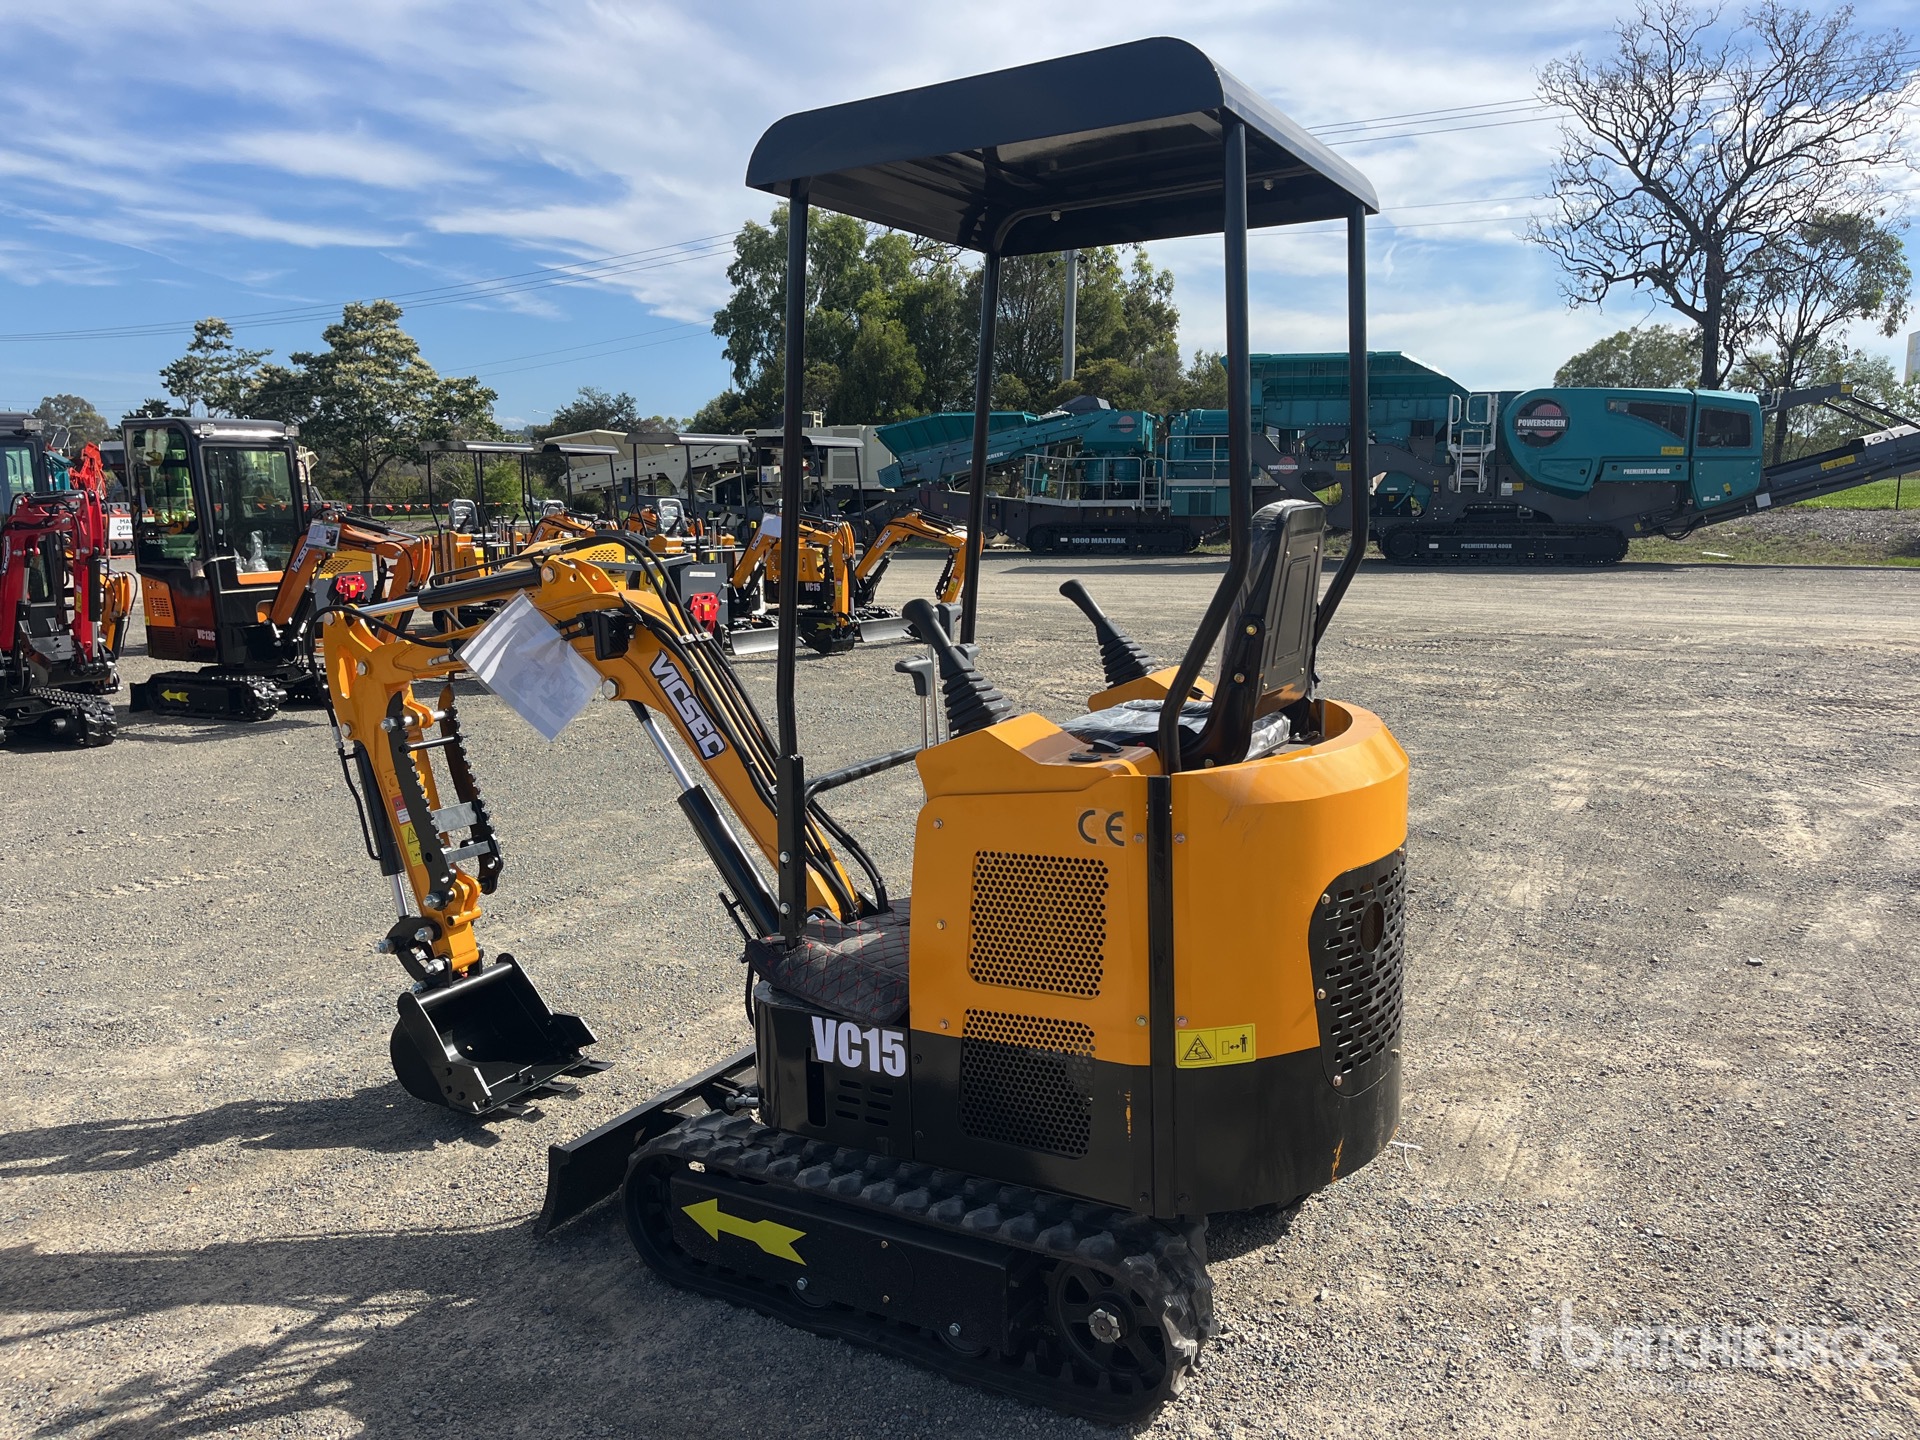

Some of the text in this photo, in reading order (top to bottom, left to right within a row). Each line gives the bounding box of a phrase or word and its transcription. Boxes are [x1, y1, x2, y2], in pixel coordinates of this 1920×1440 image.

[1518, 418, 1566, 427] POWERSCREEN
[805, 582, 821, 592] VC15
[650, 650, 725, 759] VICSEC
[1078, 809, 1125, 847] CE
[811, 1015, 906, 1078] VC15
